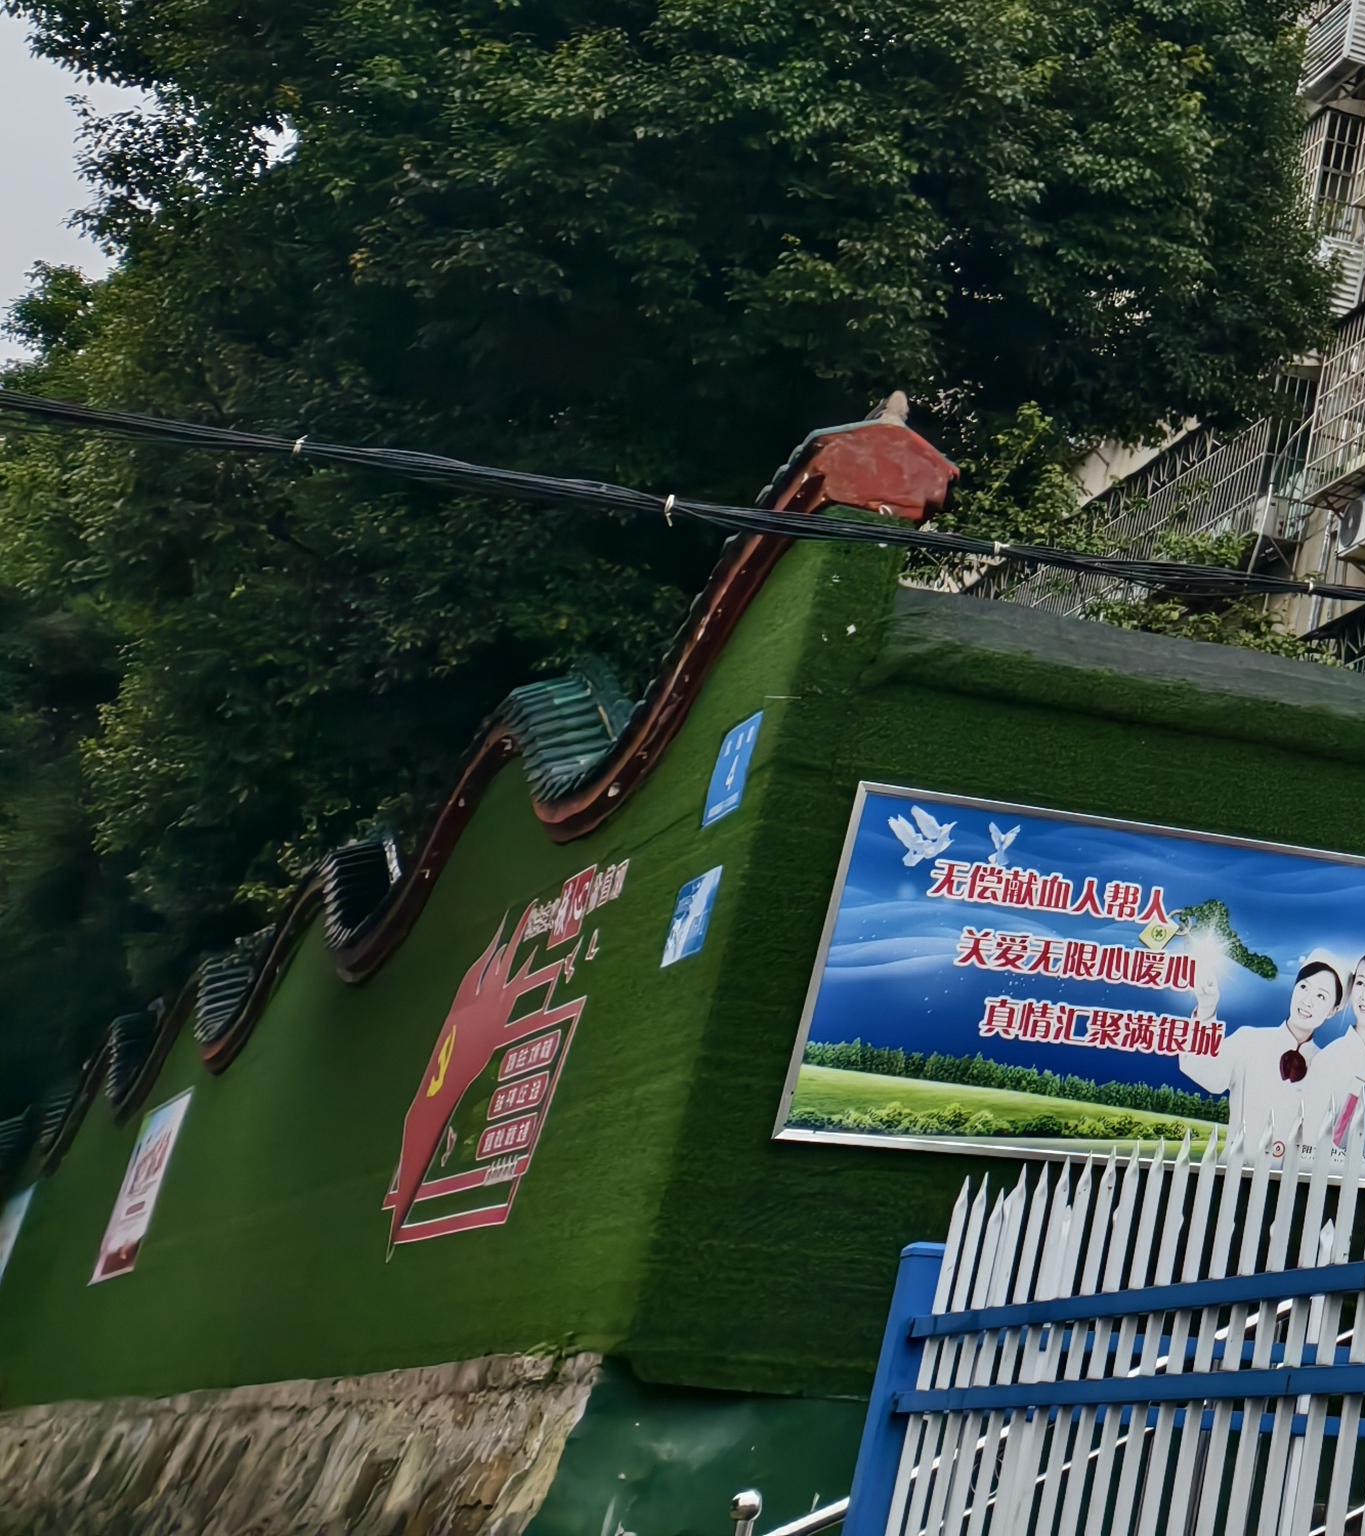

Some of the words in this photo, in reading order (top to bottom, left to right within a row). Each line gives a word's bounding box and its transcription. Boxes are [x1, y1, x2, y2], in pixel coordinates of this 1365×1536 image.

[929, 860, 1169, 924] 无偿献血人帮人
[956, 927, 1197, 990] 关爱无限心暖心
[981, 996, 1224, 1057] 真情汇聚满银城
